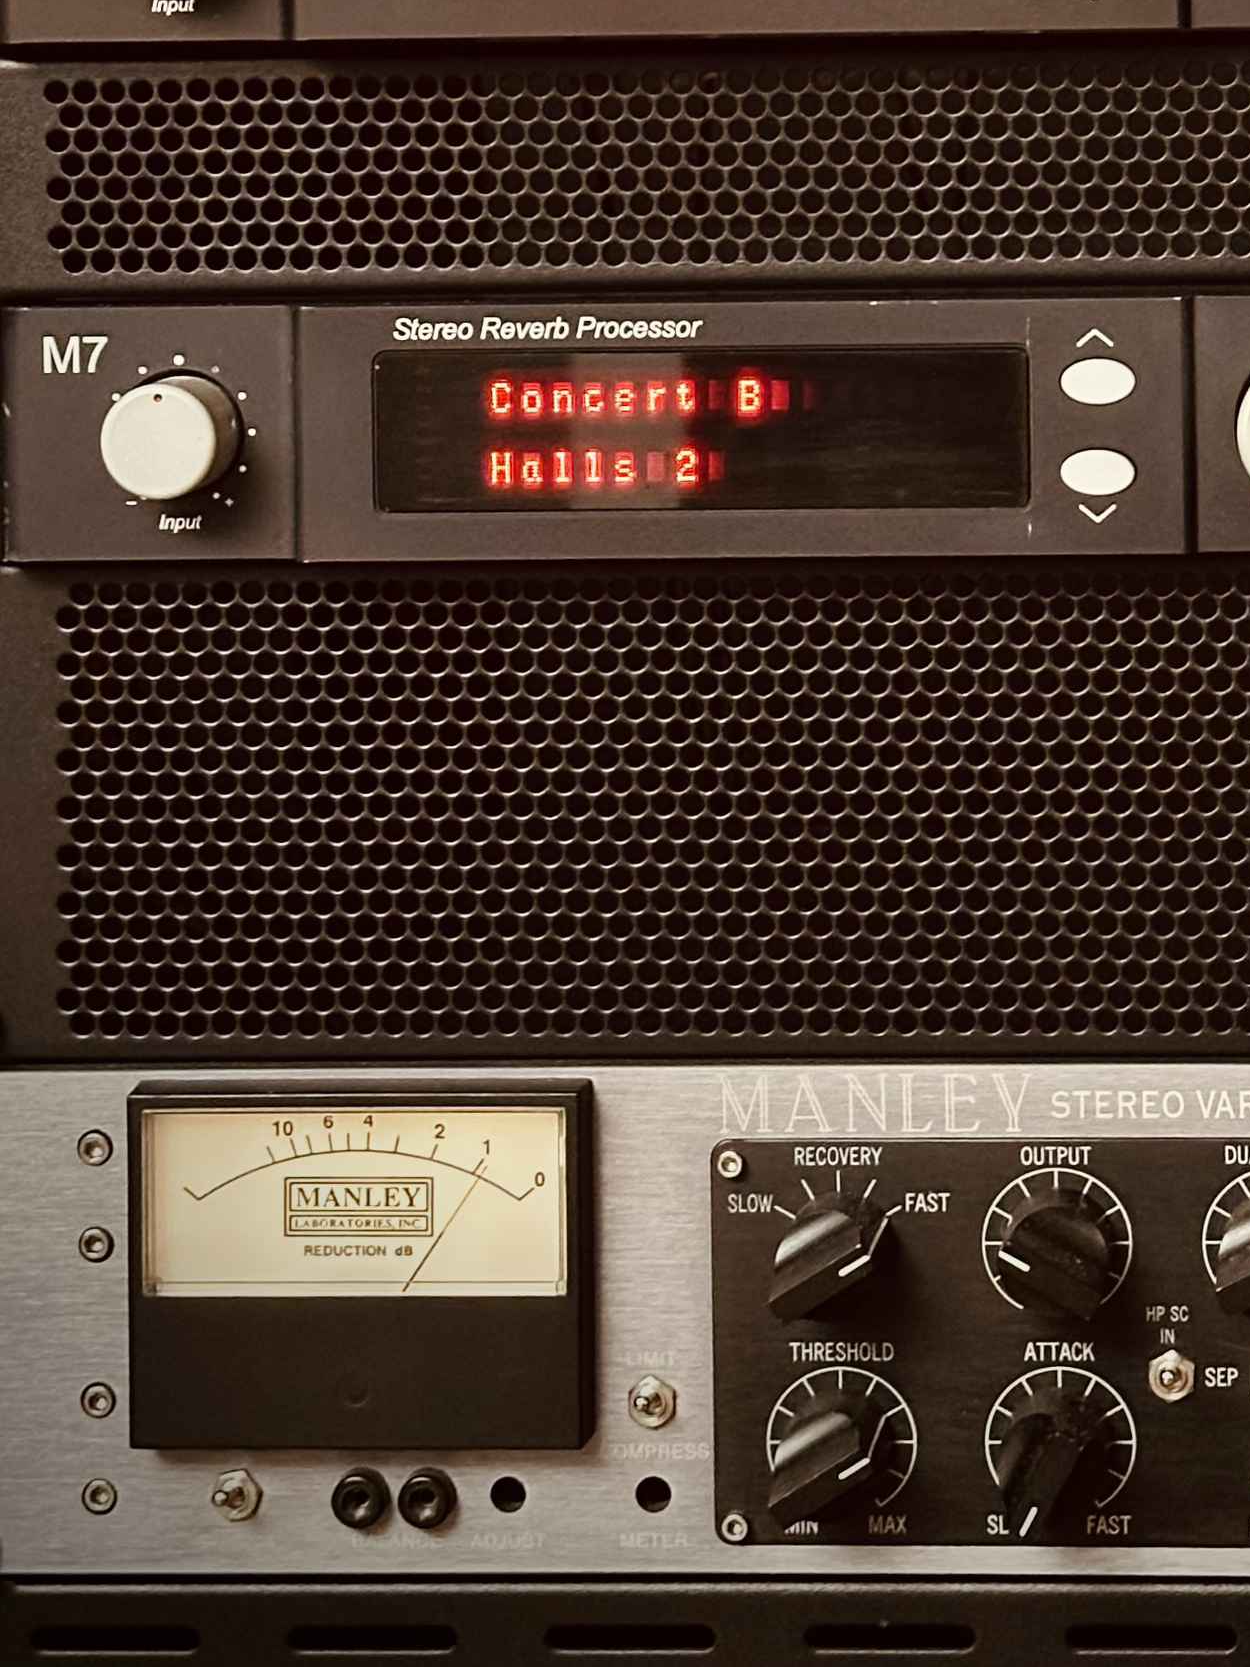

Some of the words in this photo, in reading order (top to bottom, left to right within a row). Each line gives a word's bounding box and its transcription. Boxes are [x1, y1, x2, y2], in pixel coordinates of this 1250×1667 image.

[393, 317, 474, 341] Stereo
[480, 316, 570, 340] Reverb
[575, 316, 703, 339] Processor
[42, 335, 109, 374] M7
[489, 378, 696, 415] Concert
[737, 378, 762, 412] B
[489, 450, 636, 486] Halls
[676, 448, 699, 483] 2
[159, 514, 201, 531] Input
[717, 1072, 1032, 1134] MANLEY
[1050, 1090, 1185, 1119] STEREO
[272, 1120, 294, 1137] 10
[323, 1115, 334, 1129] 6
[363, 1114, 374, 1128] 4
[434, 1124, 446, 1139] 2
[483, 1140, 491, 1155] 1
[534, 1172, 546, 1187] 0
[794, 1147, 883, 1166] RECOVERY
[1020, 1147, 1092, 1165] OUTPUT
[296, 1187, 421, 1208] MANLEY
[727, 1194, 773, 1213] SLOW
[905, 1193, 950, 1213] FAST
[303, 1245, 387, 1256] REDUCTION
[394, 1245, 413, 1256] dB
[1146, 1307, 1165, 1322] HP
[1170, 1307, 1189, 1322] SC
[1160, 1329, 1176, 1344] IN
[627, 1351, 674, 1366] LIMIT
[790, 1343, 894, 1362] THRESHOLD
[1024, 1343, 1094, 1362] ATTACK
[1205, 1369, 1238, 1387] SEP
[612, 1443, 711, 1461] OMPRESS
[869, 1516, 907, 1534] MAX
[1087, 1516, 1132, 1535] FAST
[471, 1534, 545, 1549] ADJUST
[620, 1533, 688, 1549] METER
